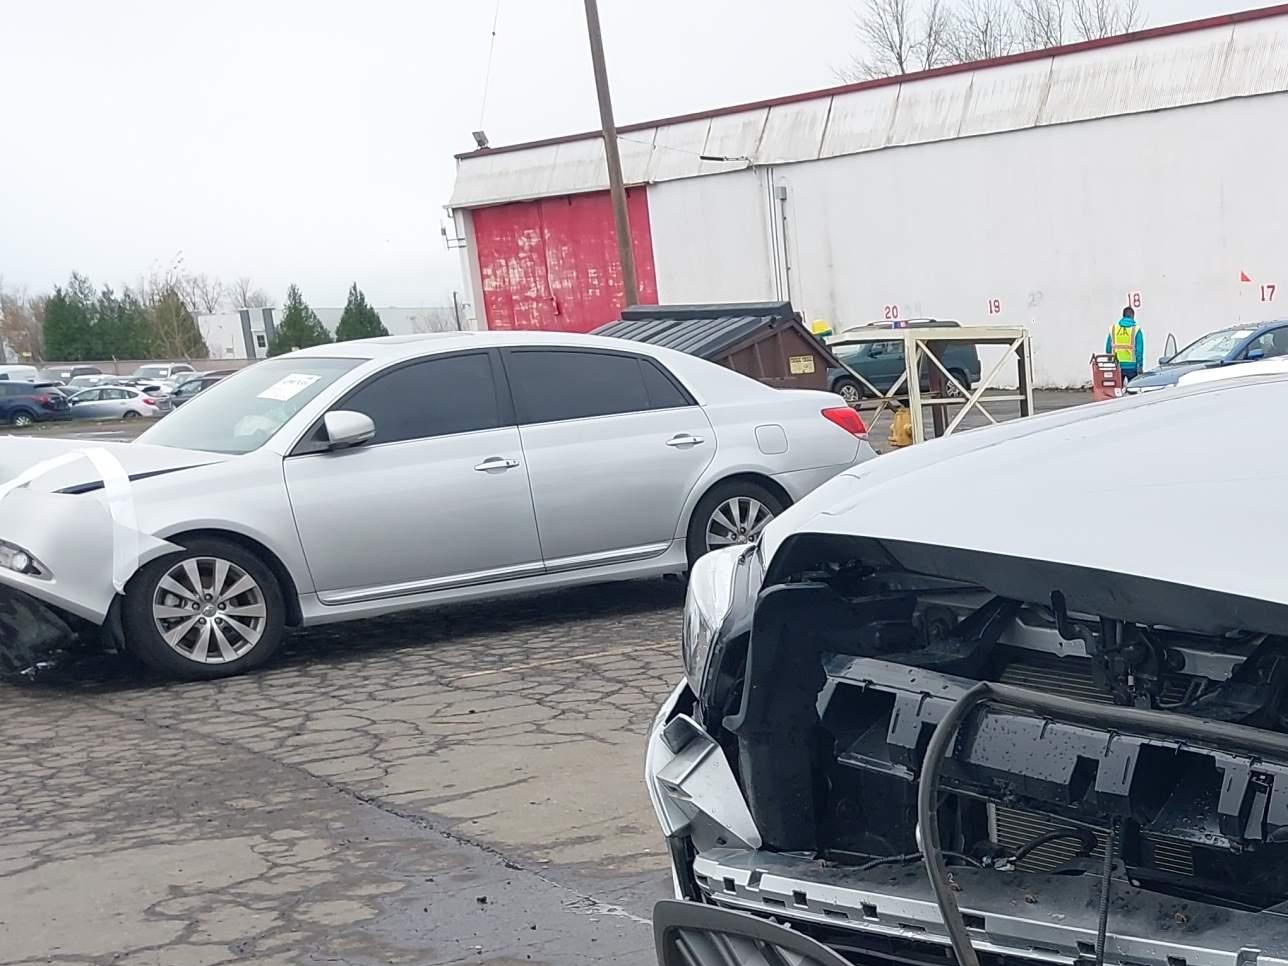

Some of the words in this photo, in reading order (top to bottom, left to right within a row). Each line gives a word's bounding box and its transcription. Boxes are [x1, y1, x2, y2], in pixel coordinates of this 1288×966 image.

[1127, 293, 1141, 308] 18
[1259, 284, 1275, 302] 17
[884, 305, 899, 320] 20
[987, 299, 1001, 315] 19
